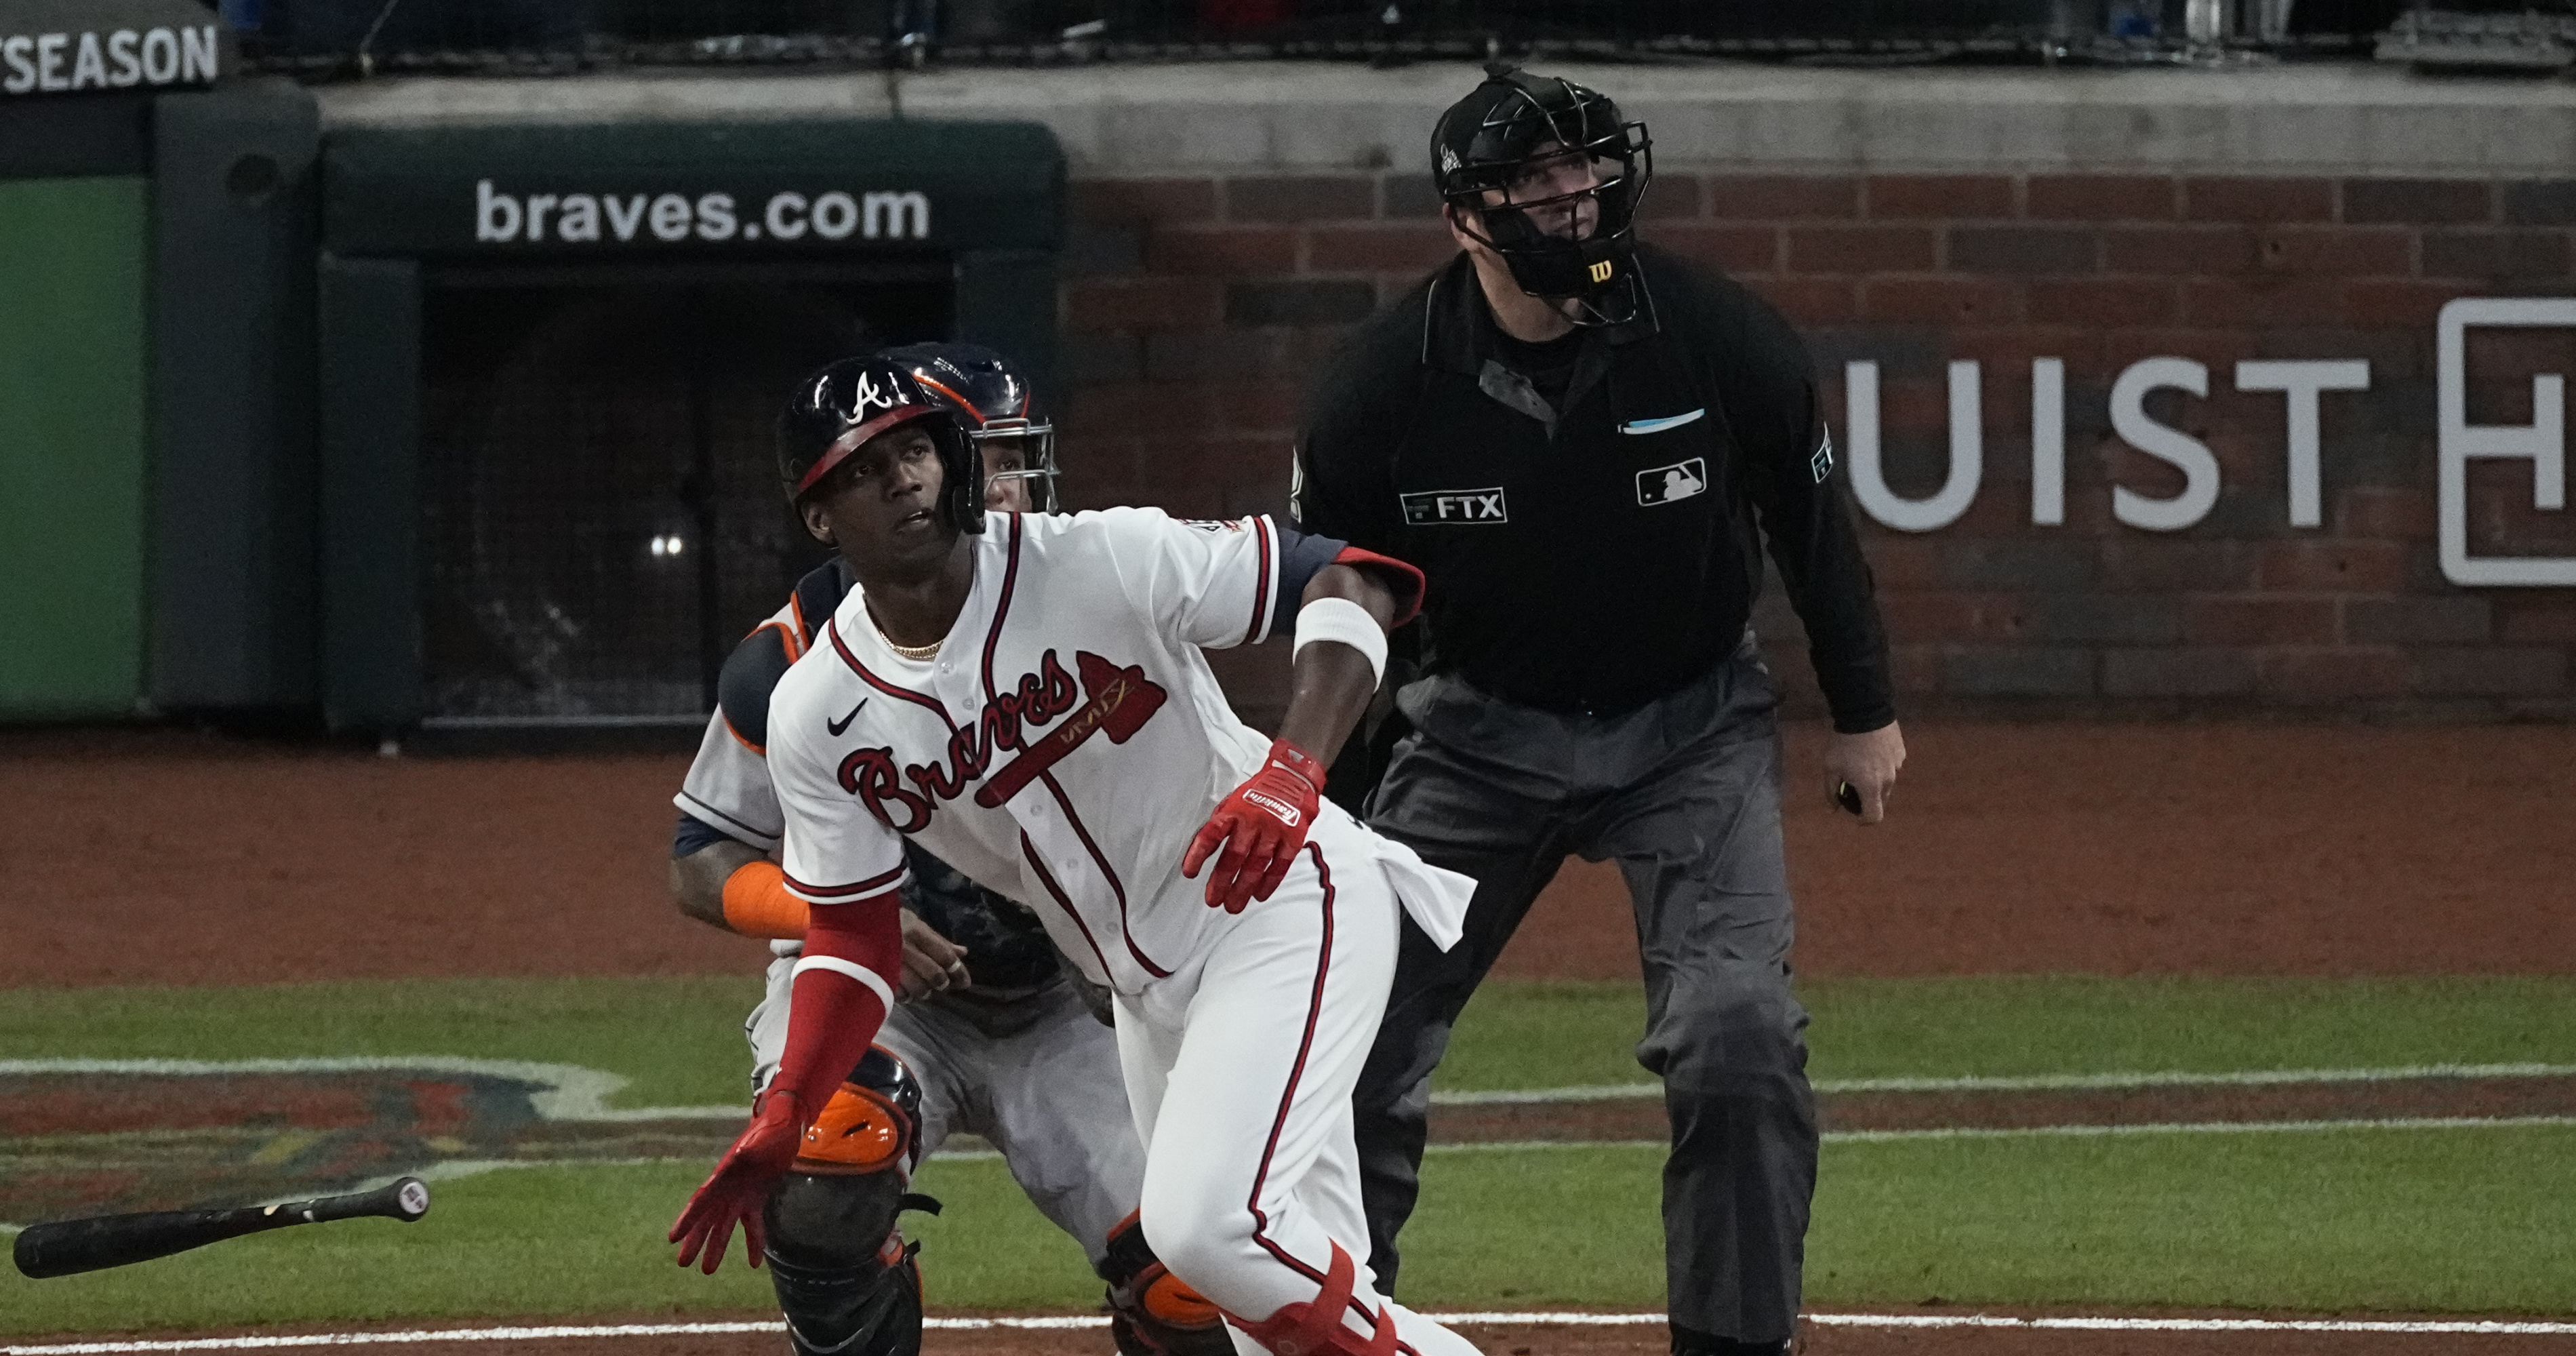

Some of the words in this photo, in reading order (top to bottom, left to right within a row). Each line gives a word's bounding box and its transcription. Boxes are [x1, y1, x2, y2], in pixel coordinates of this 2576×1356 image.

[0, 25, 217, 92] SEASON
[476, 179, 929, 241] braves.com
[847, 371, 892, 425] A
[1436, 494, 1504, 519] FTX
[837, 648, 1078, 834] Braves
[1249, 793, 1297, 820] Franklin
